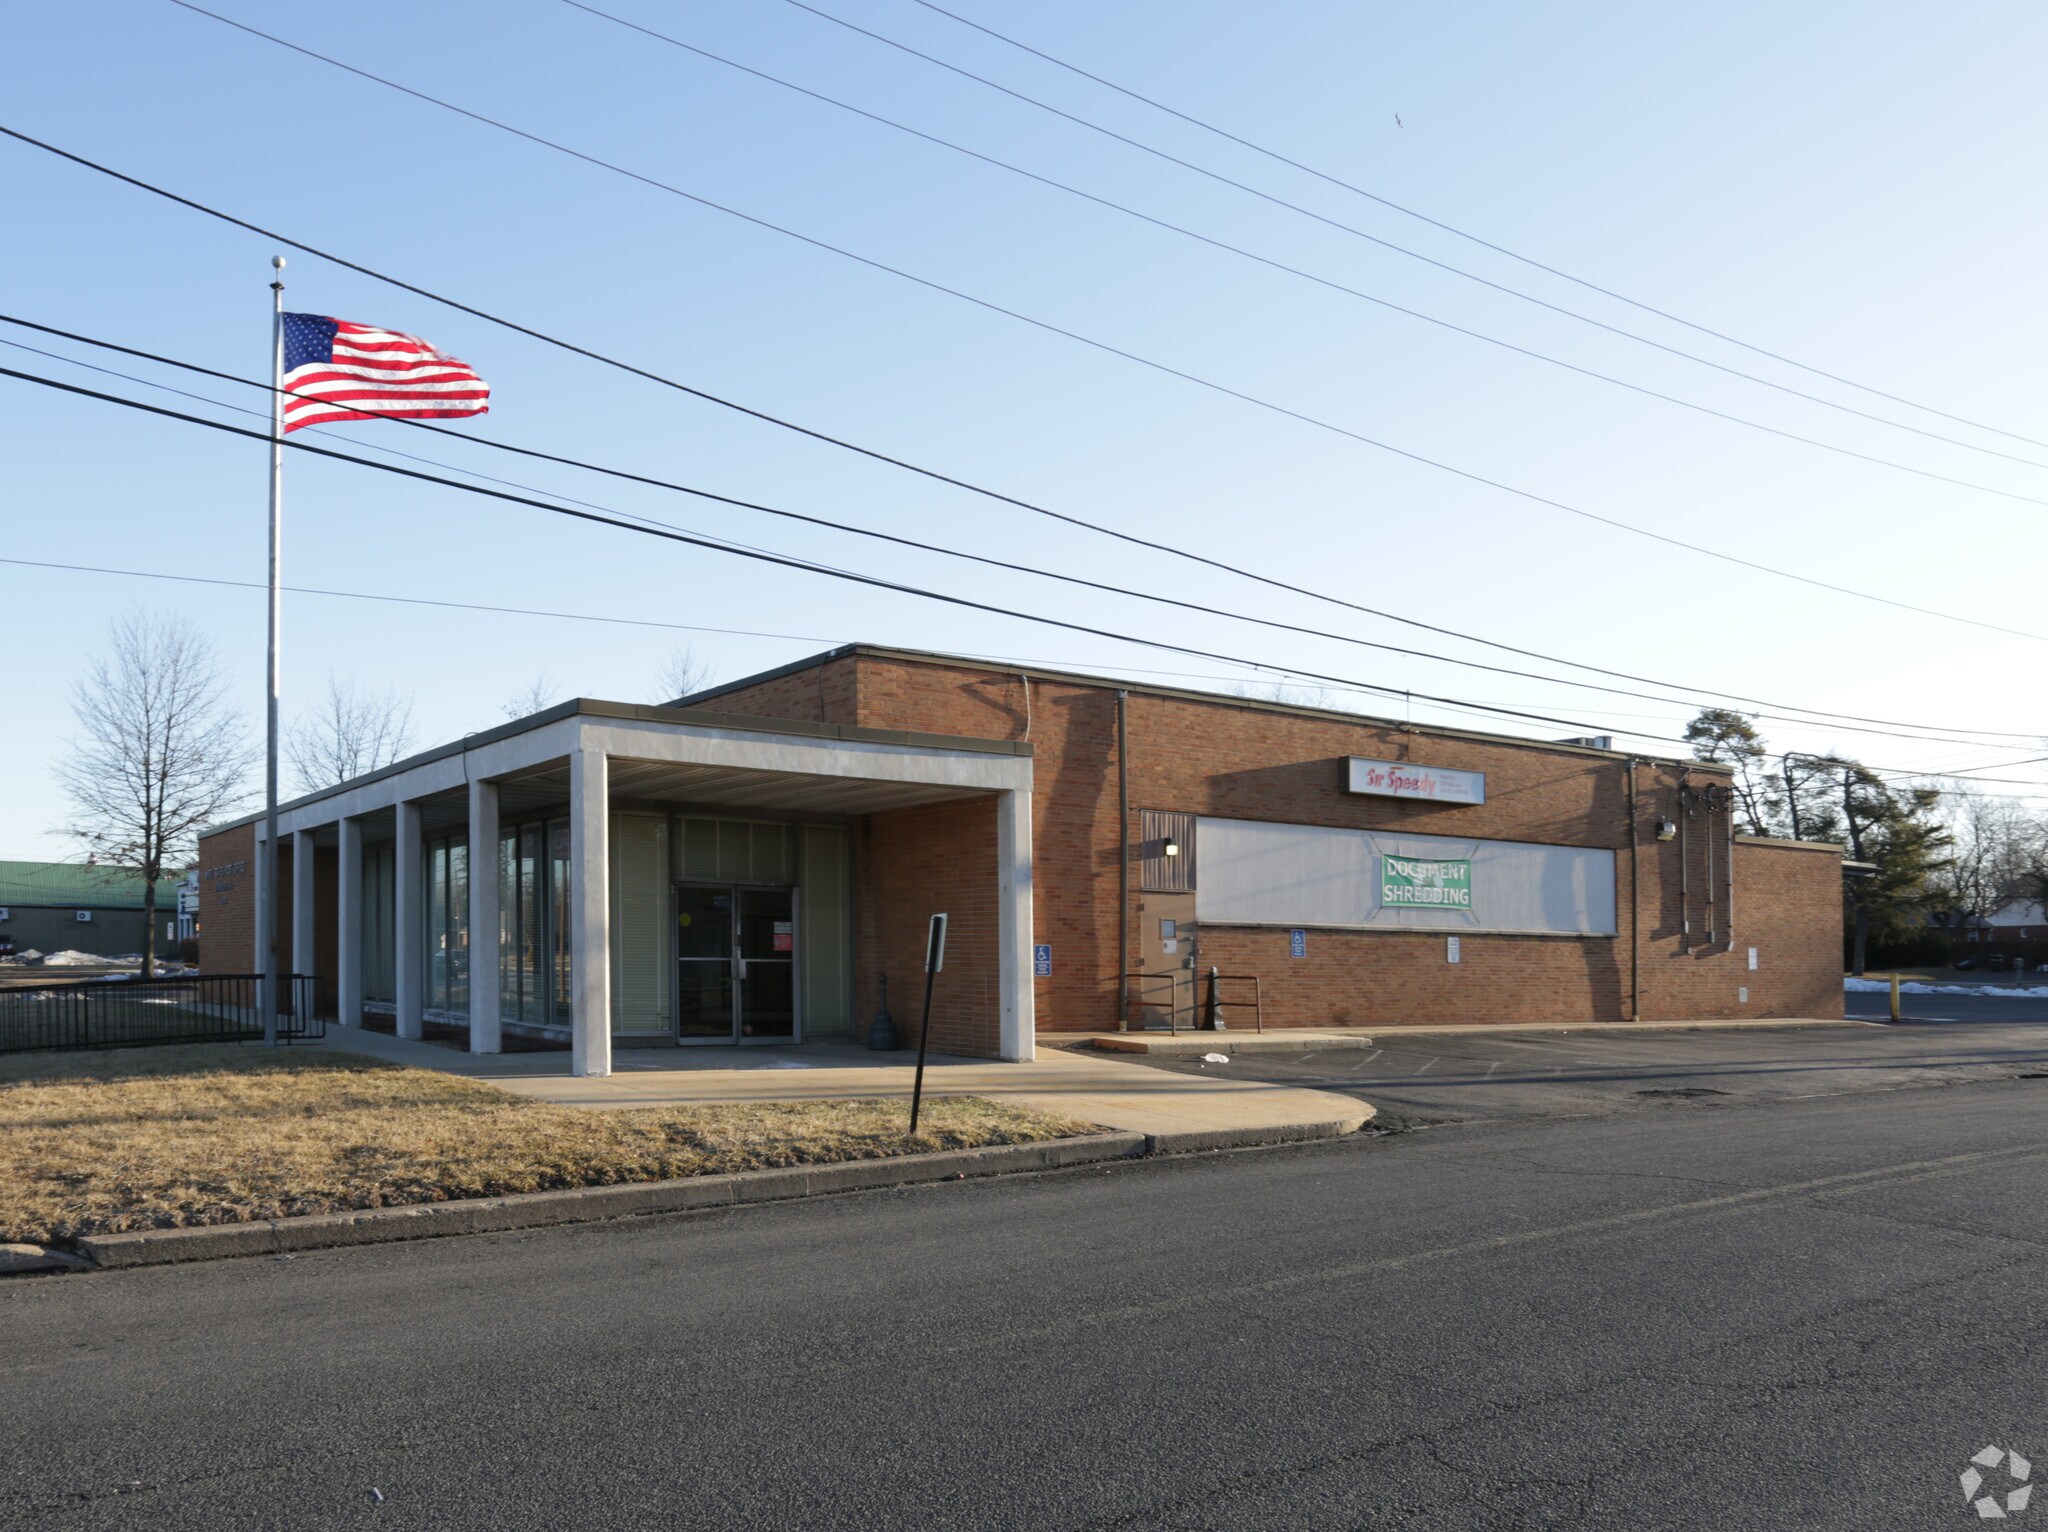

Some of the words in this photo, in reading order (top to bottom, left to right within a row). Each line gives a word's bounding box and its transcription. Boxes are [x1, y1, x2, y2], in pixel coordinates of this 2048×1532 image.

[1387, 770, 1436, 798] Speedy
[1387, 859, 1467, 880] DOCUMENT
[1384, 885, 1469, 904] SHREDDING
